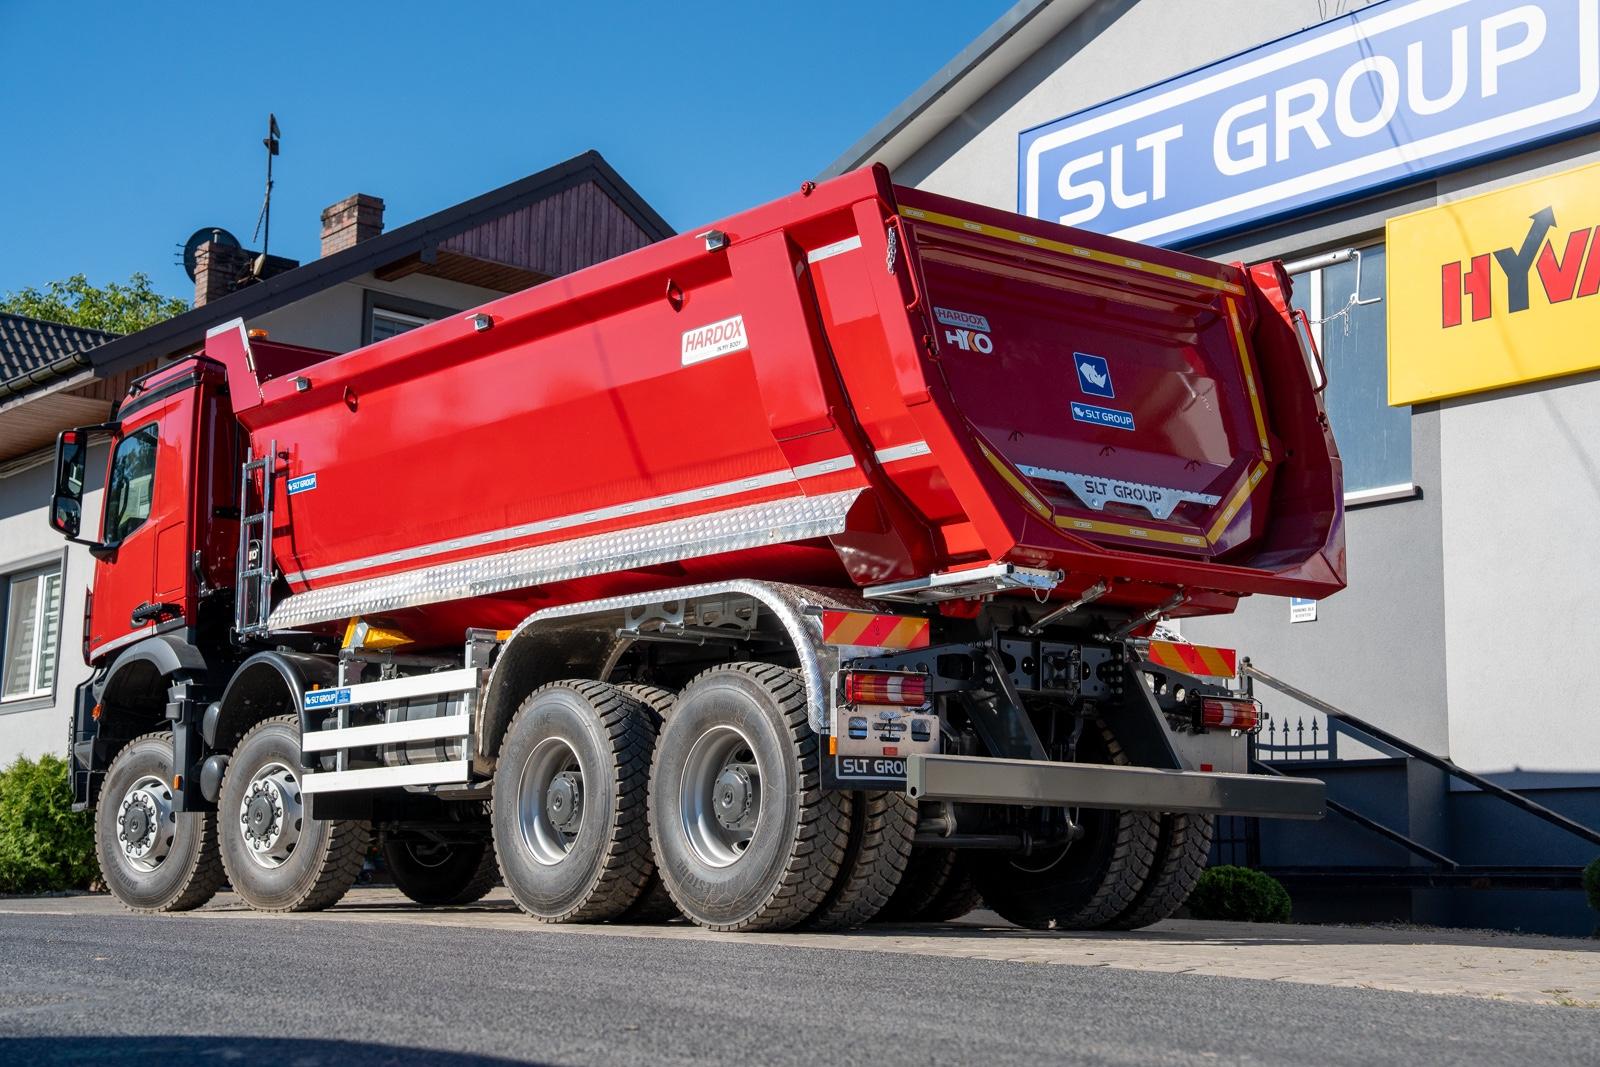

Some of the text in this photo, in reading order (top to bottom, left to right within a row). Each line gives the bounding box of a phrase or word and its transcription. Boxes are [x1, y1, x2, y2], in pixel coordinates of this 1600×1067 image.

[1058, 5, 1546, 226] SLT GROUP
[937, 309, 984, 326] HARDOX
[685, 319, 742, 352] HARDOX
[1085, 409, 1132, 425] SLT GROUP
[300, 477, 316, 488] GROUP
[1084, 480, 1162, 503] SLT GROUP
[311, 695, 319, 704] SLT
[319, 693, 336, 703] GROUP
[842, 758, 869, 773] SLT
